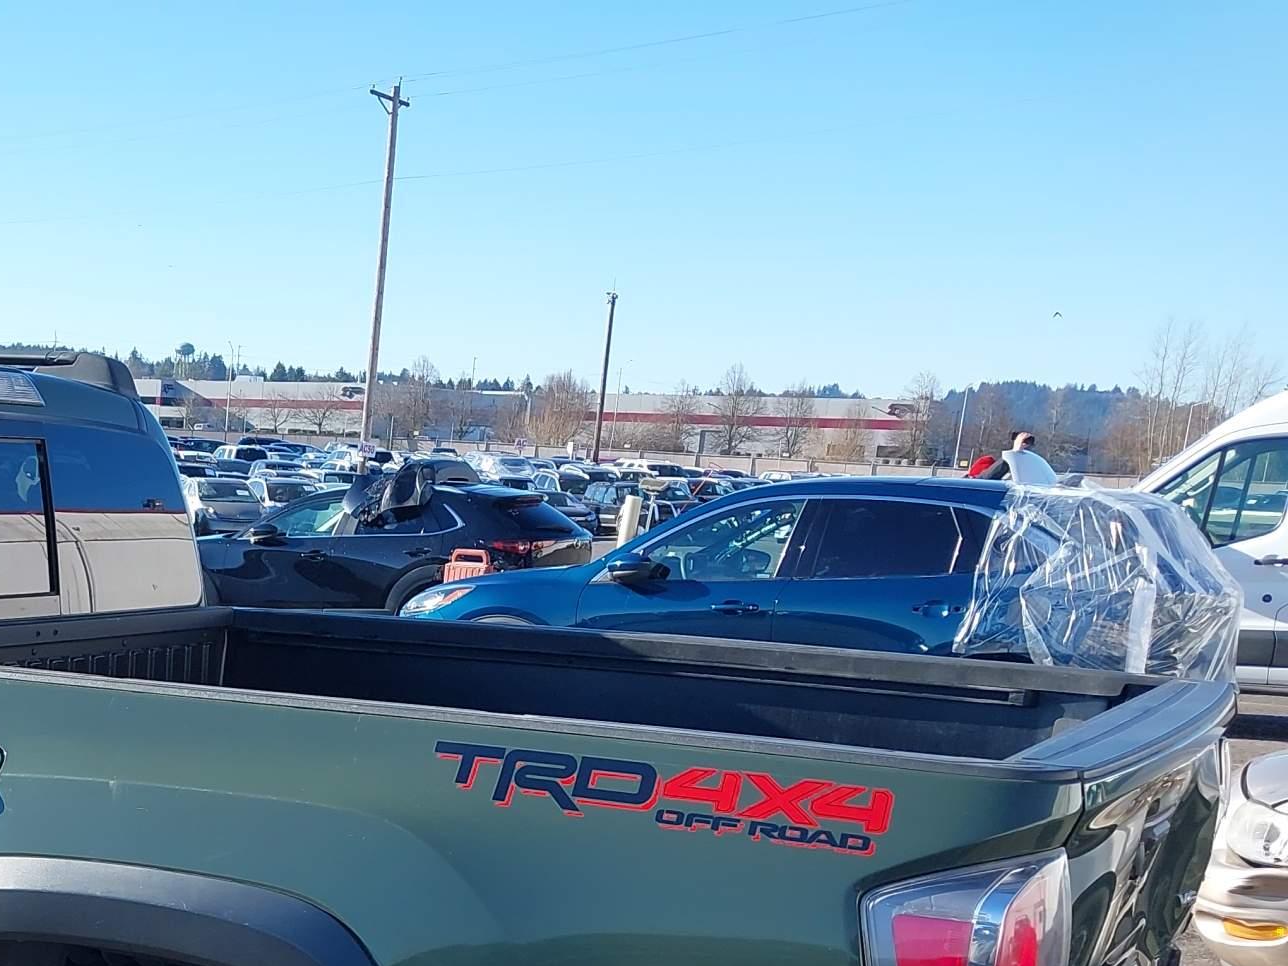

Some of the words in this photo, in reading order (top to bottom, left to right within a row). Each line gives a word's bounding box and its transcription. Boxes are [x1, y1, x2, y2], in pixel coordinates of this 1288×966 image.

[434, 740, 661, 817] TRD
[663, 767, 893, 834] 4X4
[655, 809, 742, 834] OFF
[748, 822, 874, 856] ROAD
